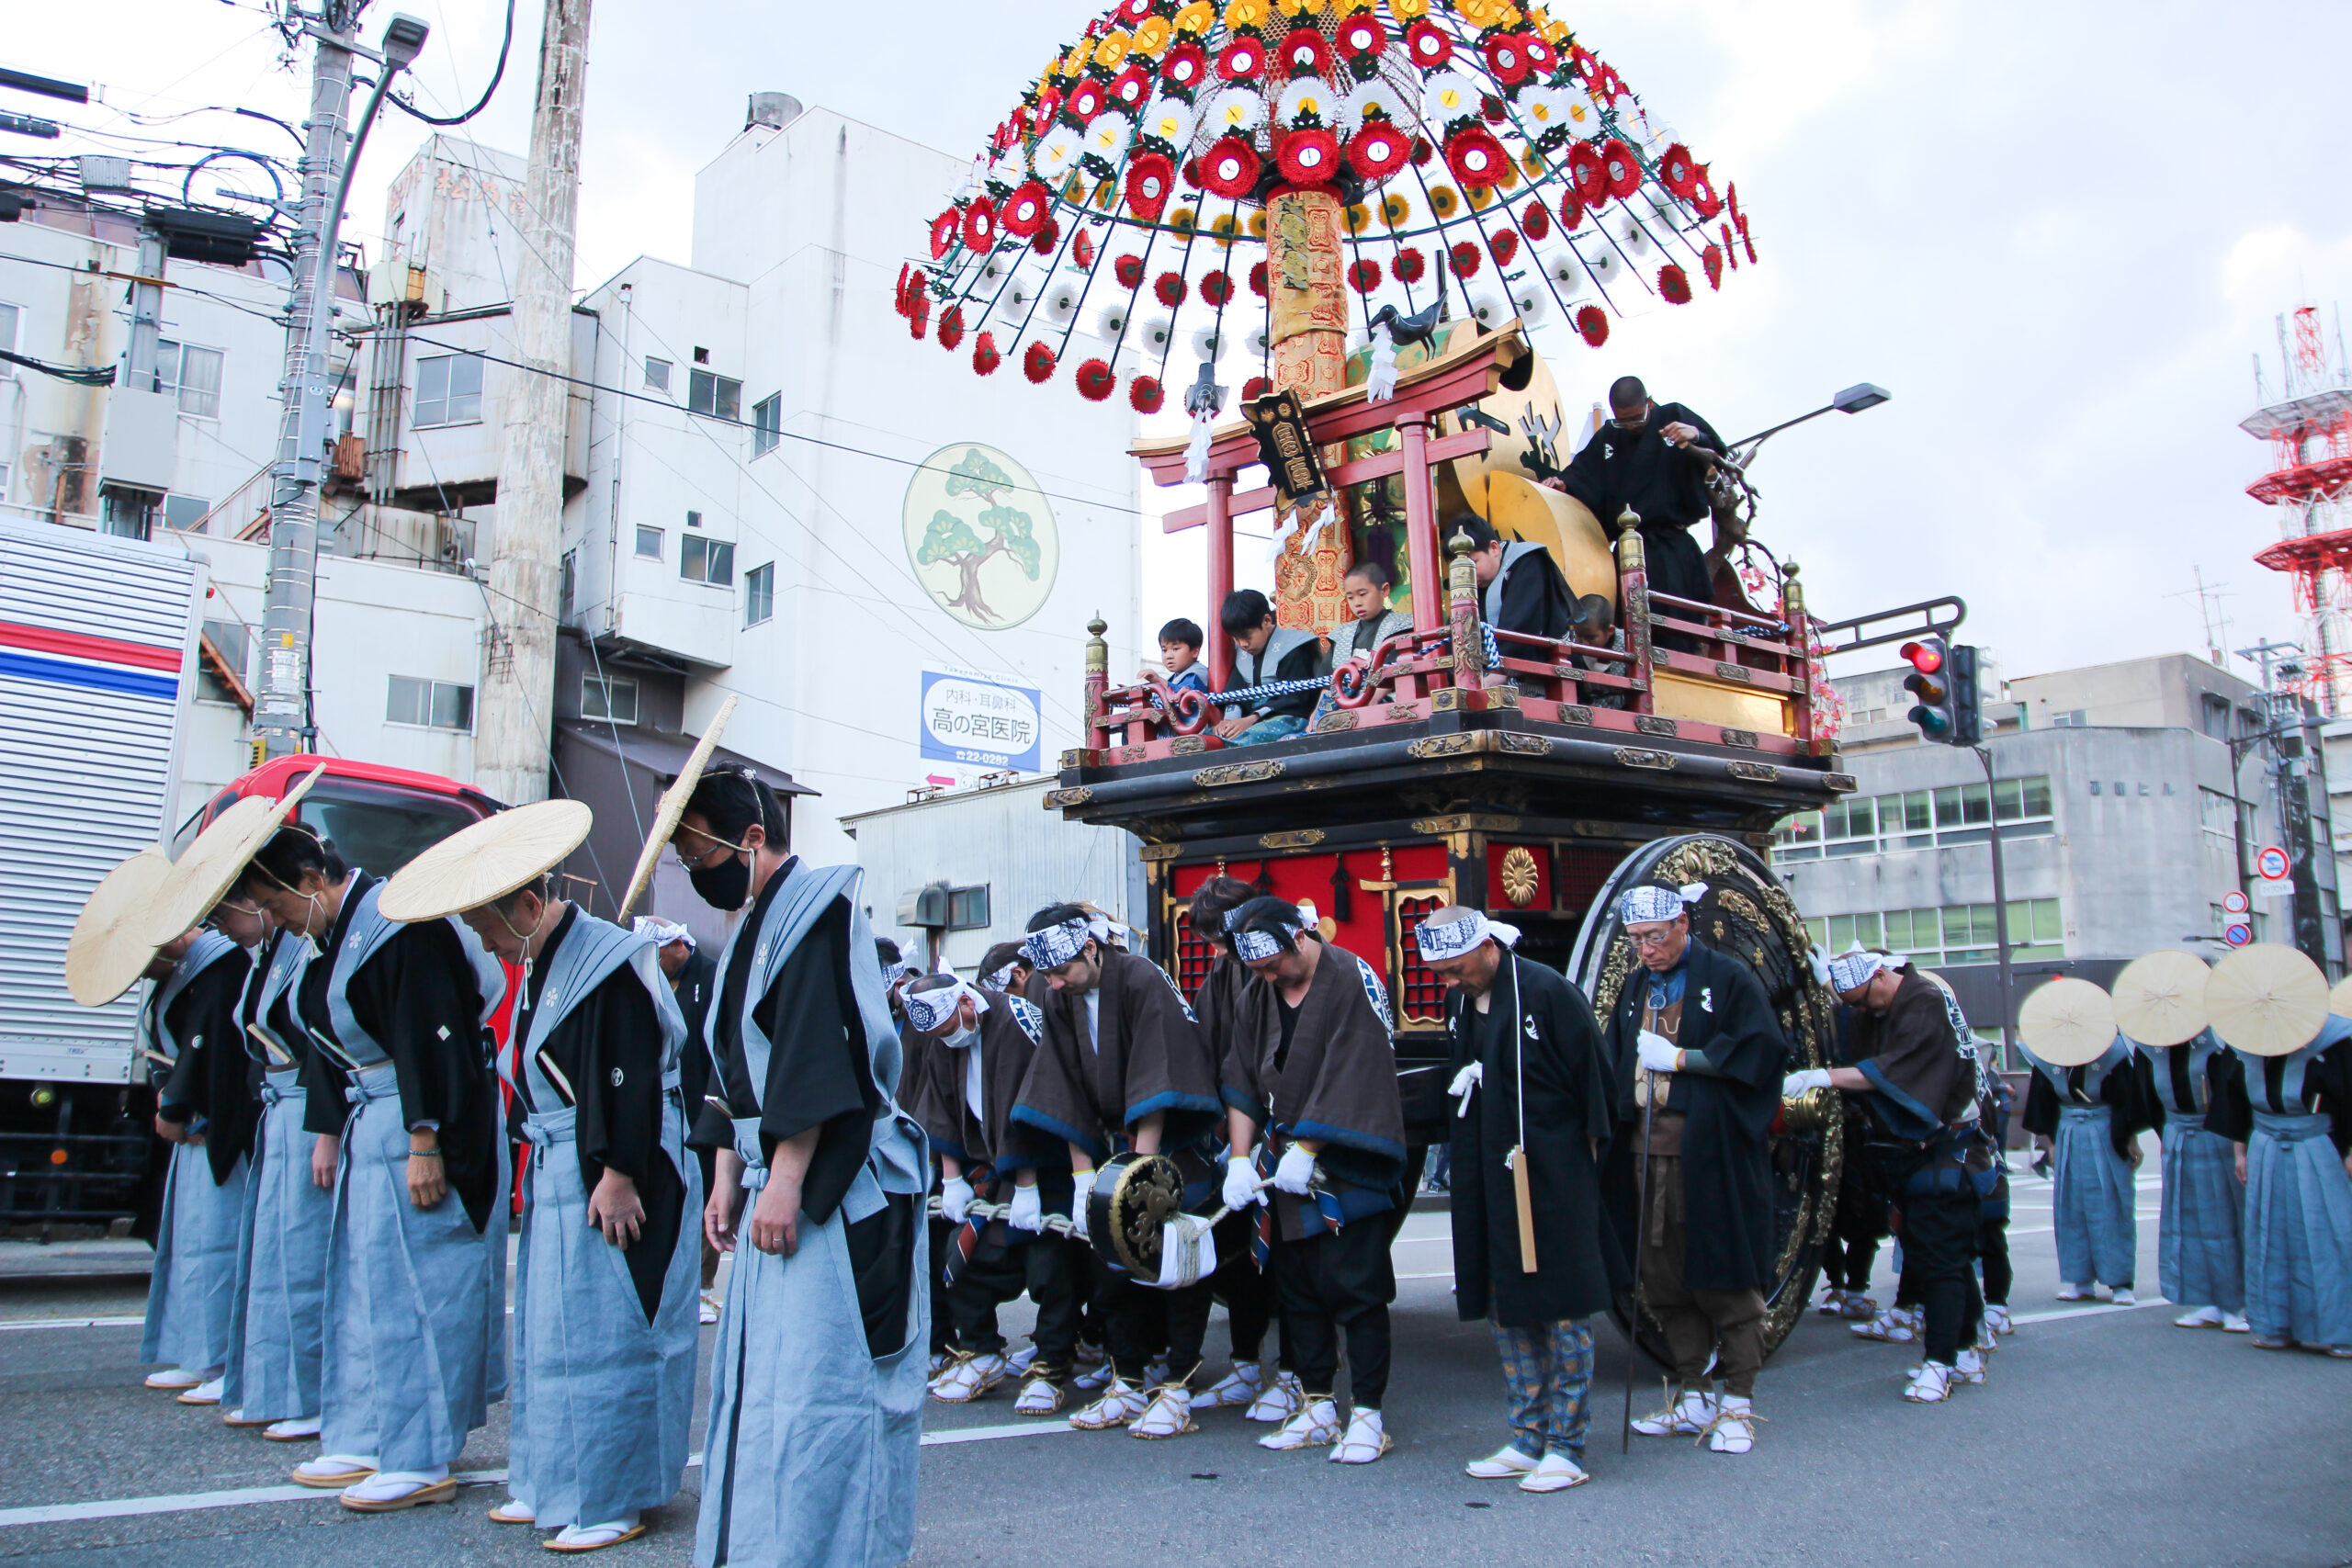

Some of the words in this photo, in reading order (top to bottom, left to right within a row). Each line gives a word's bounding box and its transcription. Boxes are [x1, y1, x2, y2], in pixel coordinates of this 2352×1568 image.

[933, 707, 1030, 744] 高の宮医院
